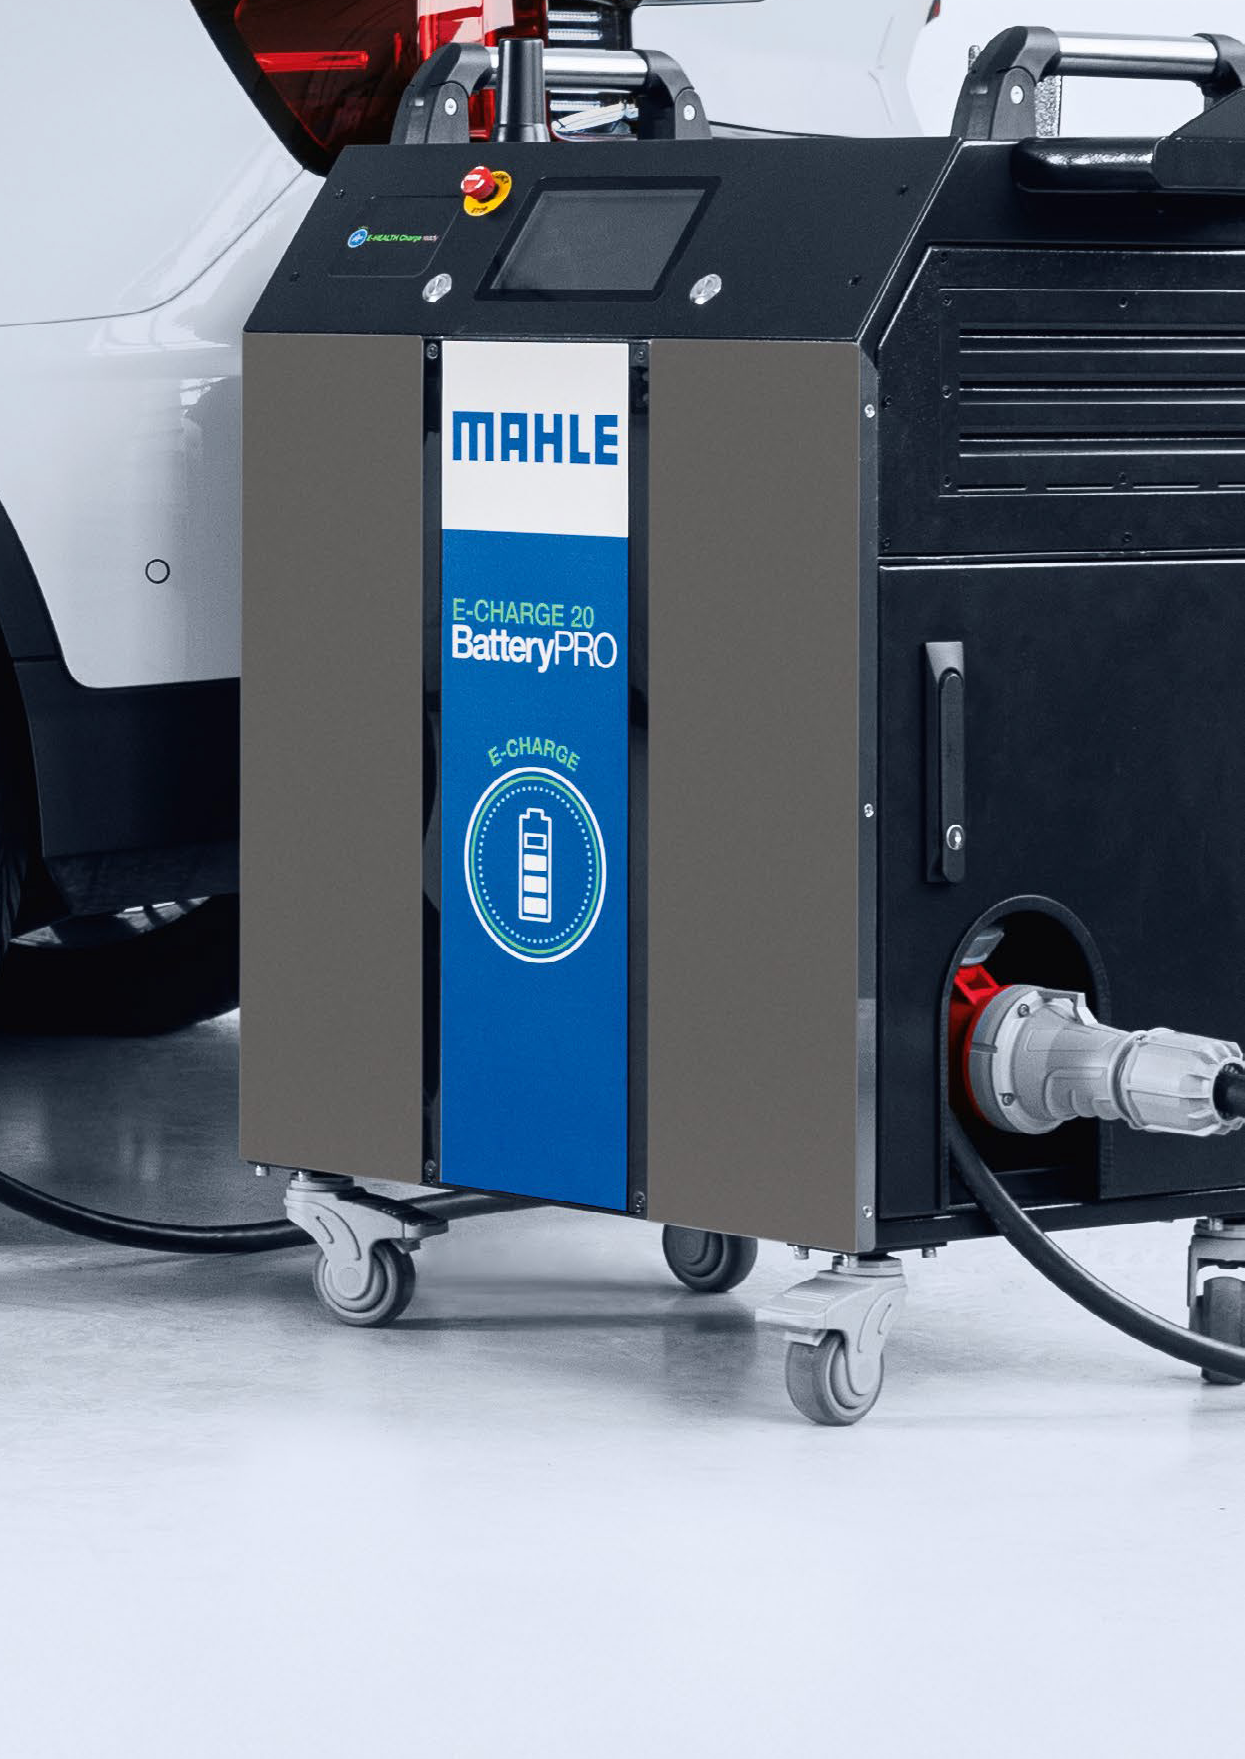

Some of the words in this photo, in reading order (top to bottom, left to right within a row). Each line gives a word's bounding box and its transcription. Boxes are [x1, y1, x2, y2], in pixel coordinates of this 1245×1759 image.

[366, 234, 399, 242] E-HEALTH
[399, 234, 422, 243] Charge
[452, 410, 618, 466] MAHLE
[452, 598, 565, 627] E-CHARGE
[570, 605, 595, 629] 20
[451, 624, 618, 674] BatteryPRO
[487, 736, 581, 772] E-CHARGE
